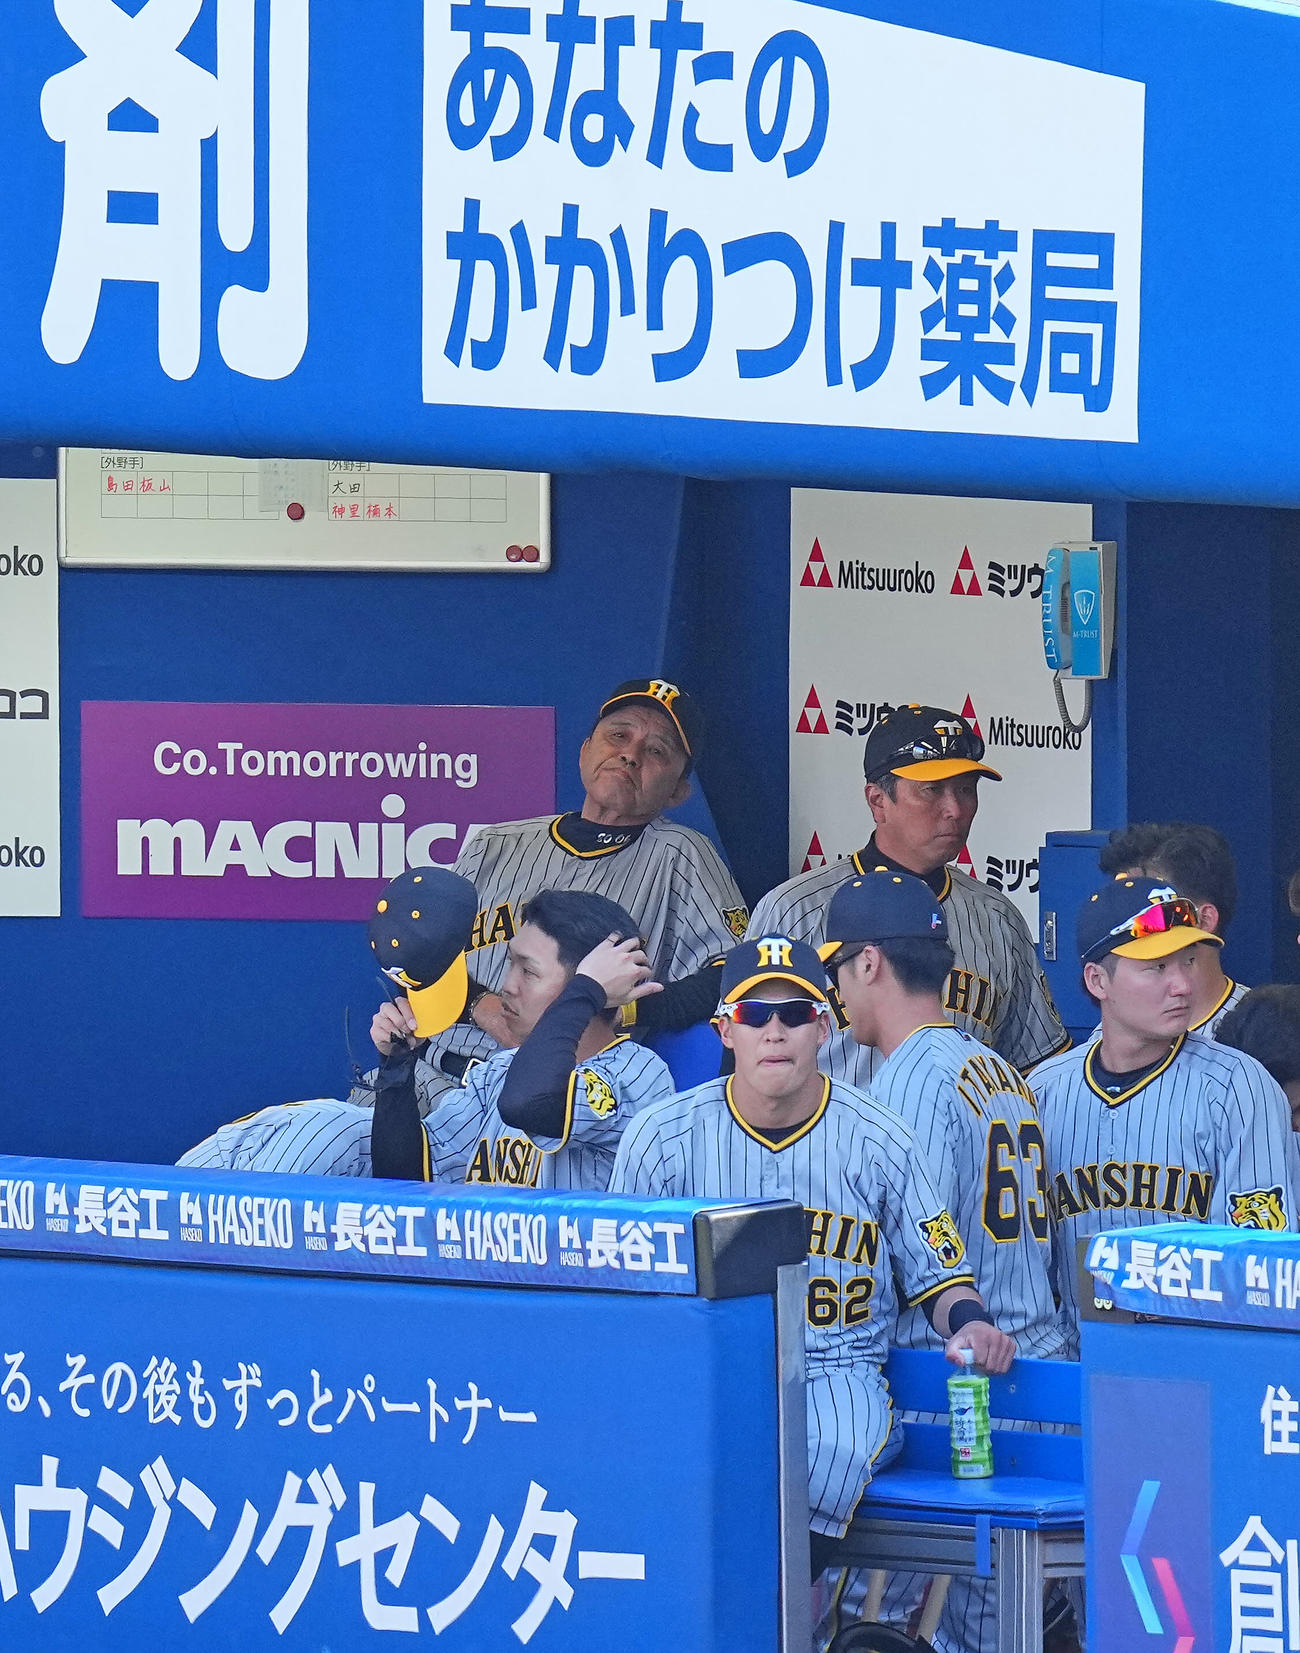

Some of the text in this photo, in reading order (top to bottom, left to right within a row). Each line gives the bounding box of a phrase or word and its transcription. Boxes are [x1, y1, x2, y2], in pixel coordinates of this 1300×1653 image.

[446, 0, 829, 178] あなたの
[40, 0, 309, 381] 剤
[443, 197, 1118, 413] かかりつけ薬局
[100, 456, 144, 470] [外野手]
[837, 560, 935, 593] Mitsuuroko
[986, 560, 1045, 599] ミツウ
[153, 741, 478, 788] Co.Tomorrowing
[988, 716, 1082, 751] Mitsuuroko
[981, 1119, 1049, 1243] 63
[74, 1183, 169, 1240] 長谷工
[208, 1193, 293, 1249] HASEKO
[331, 1201, 428, 1257] 長谷工
[464, 1209, 548, 1266] HASEKO
[586, 1218, 689, 1275] 長谷工
[806, 1275, 875, 1328] 62
[1121, 1239, 1225, 1302] 長谷工
[0, 1350, 538, 1445] る、その後もずっとパートナー
[1260, 1384, 1300, 1455] 住
